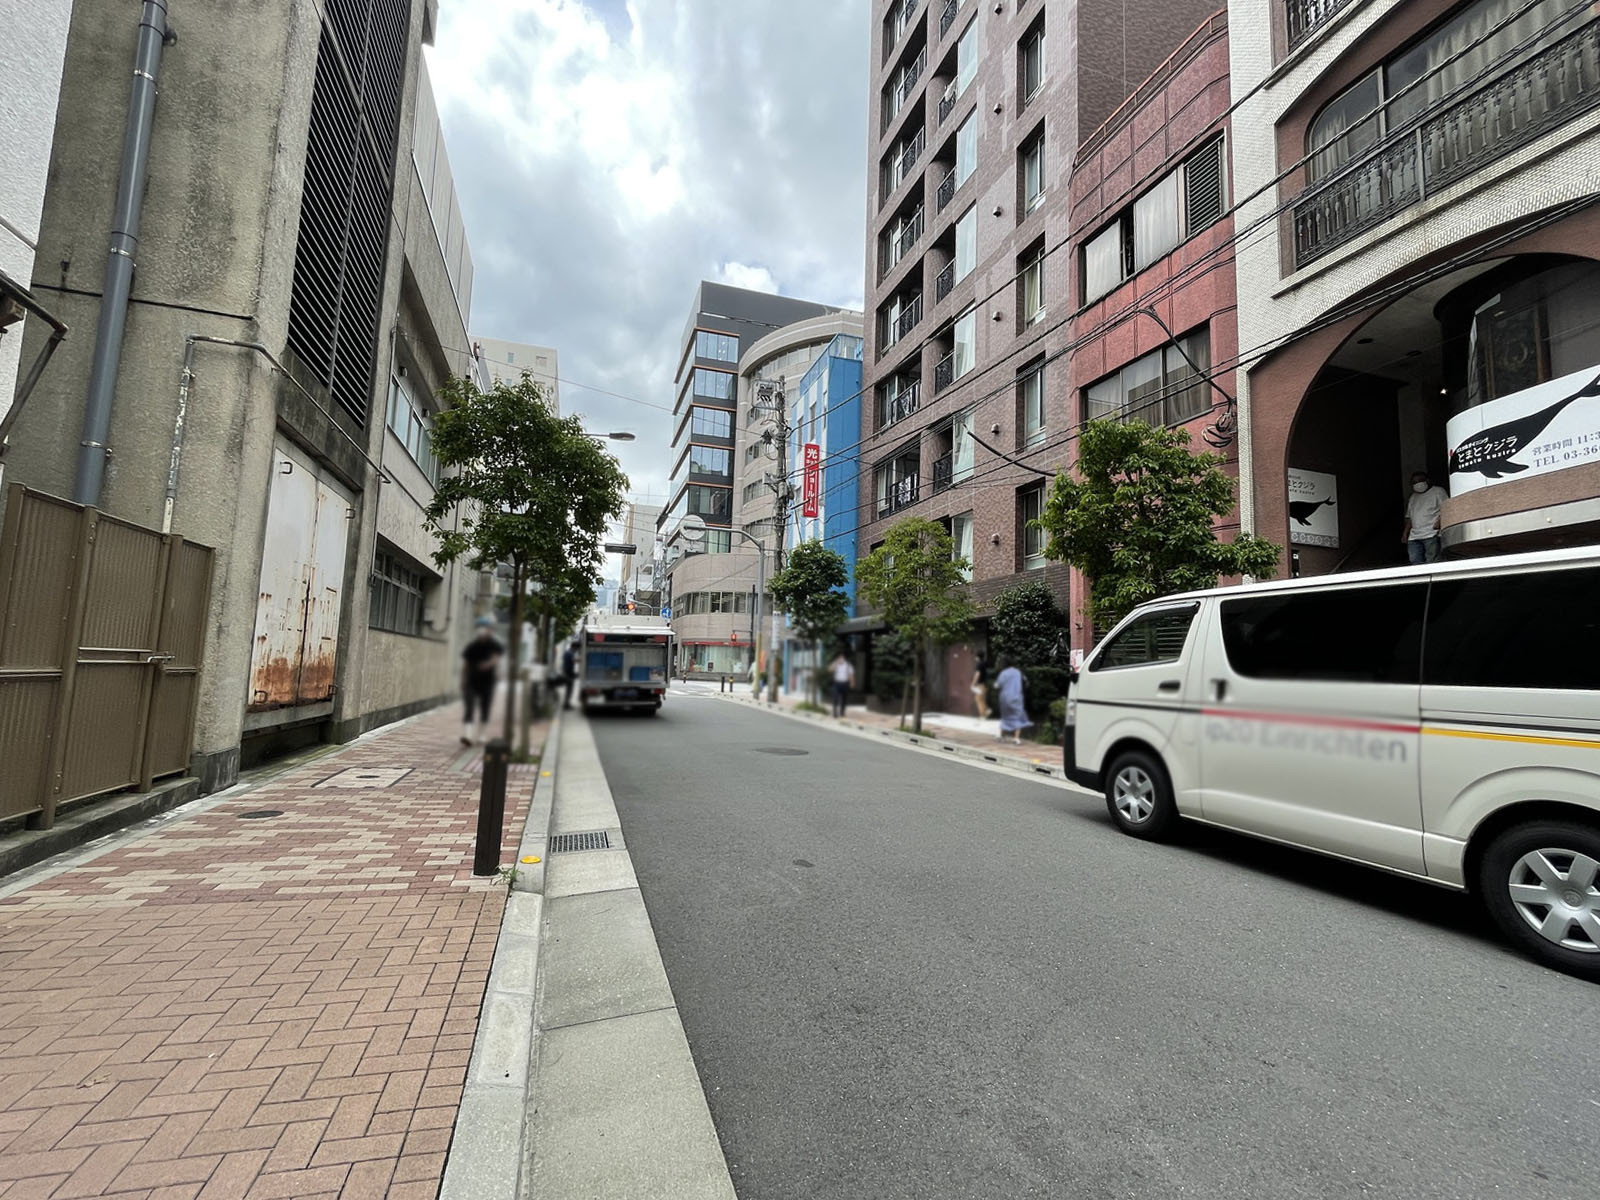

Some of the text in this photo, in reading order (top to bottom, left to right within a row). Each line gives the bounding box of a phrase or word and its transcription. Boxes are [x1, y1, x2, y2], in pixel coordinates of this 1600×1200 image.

[1458, 435, 1518, 463] とまとクジラ
[1532, 438, 1573, 456] 営業時間
[1533, 444, 1600, 468] TEL 03-36
